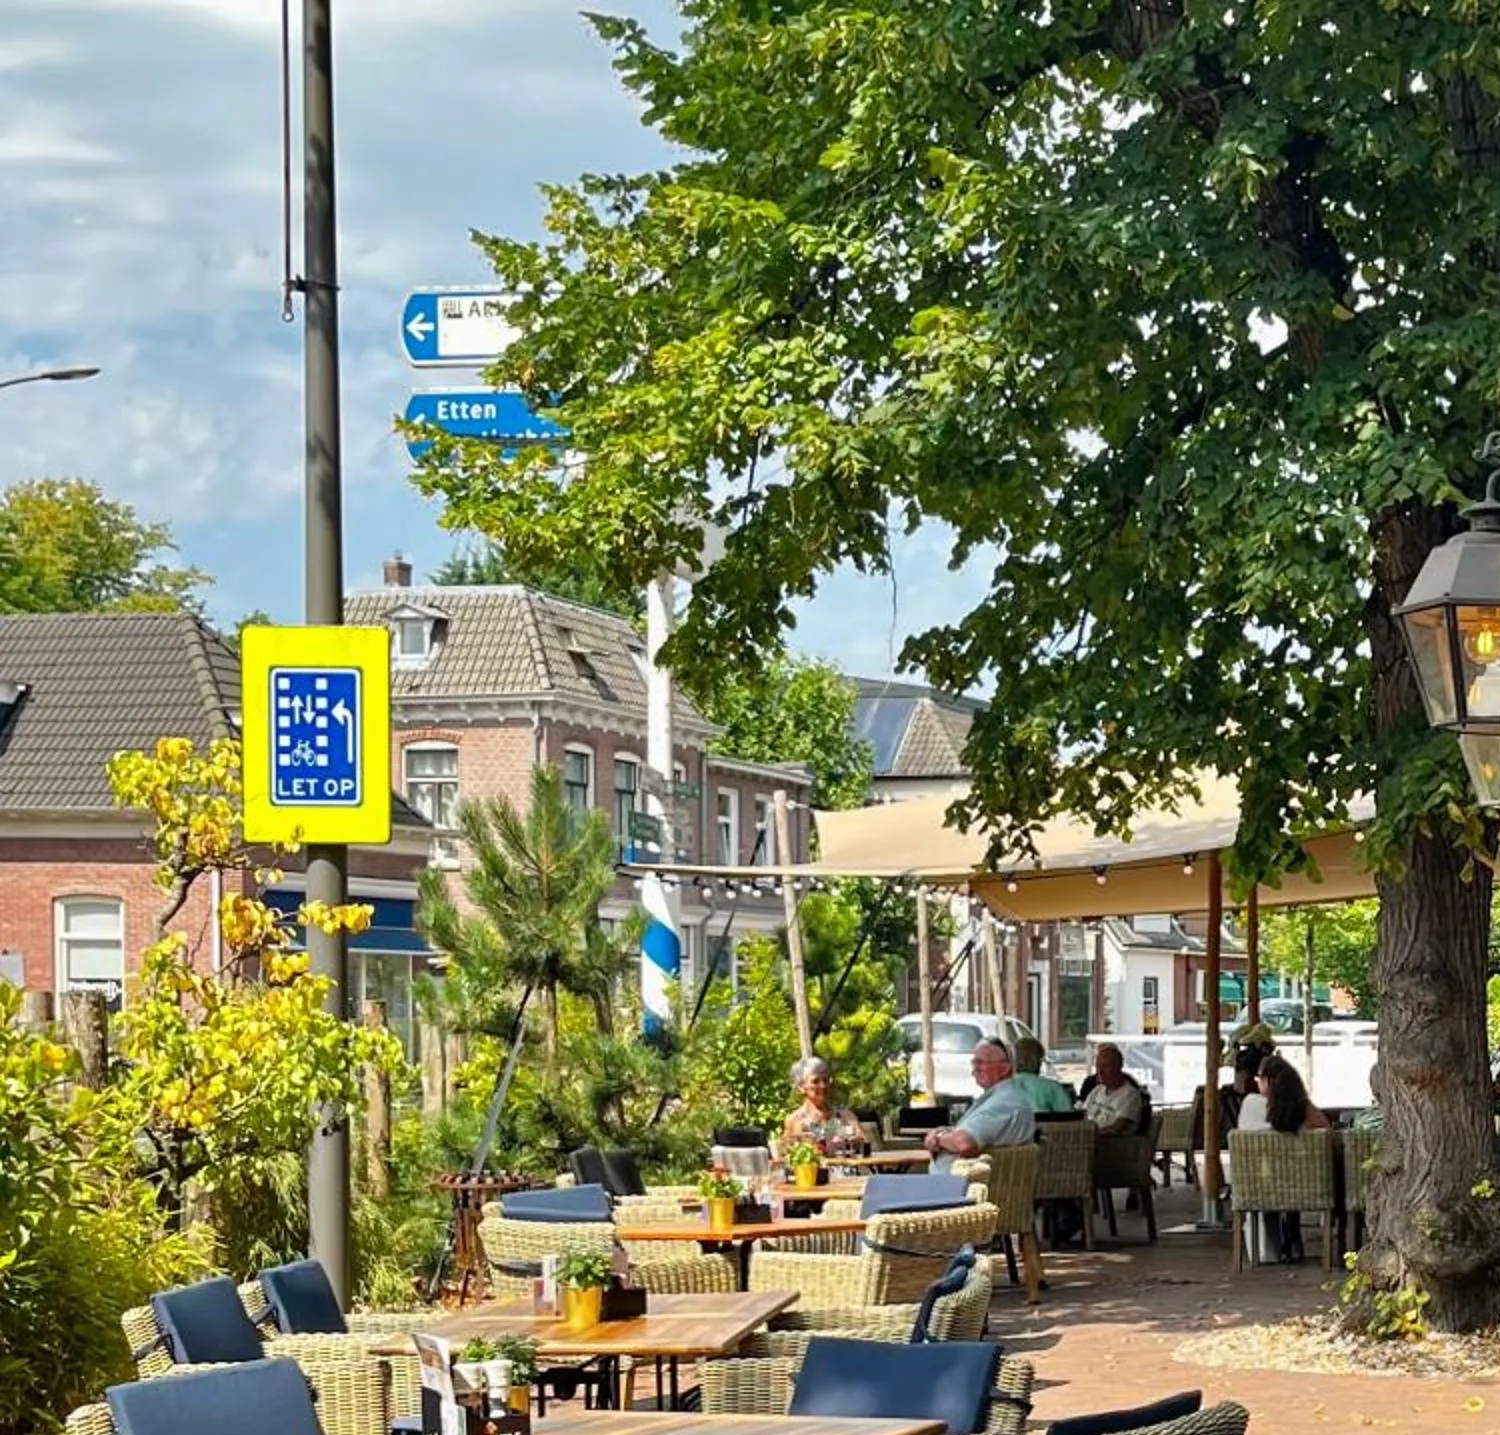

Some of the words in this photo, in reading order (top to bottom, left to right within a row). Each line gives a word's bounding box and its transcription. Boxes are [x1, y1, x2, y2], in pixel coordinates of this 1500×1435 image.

[437, 401, 497, 420] Etten
[278, 779, 318, 796] LET
[323, 778, 354, 796] OP
